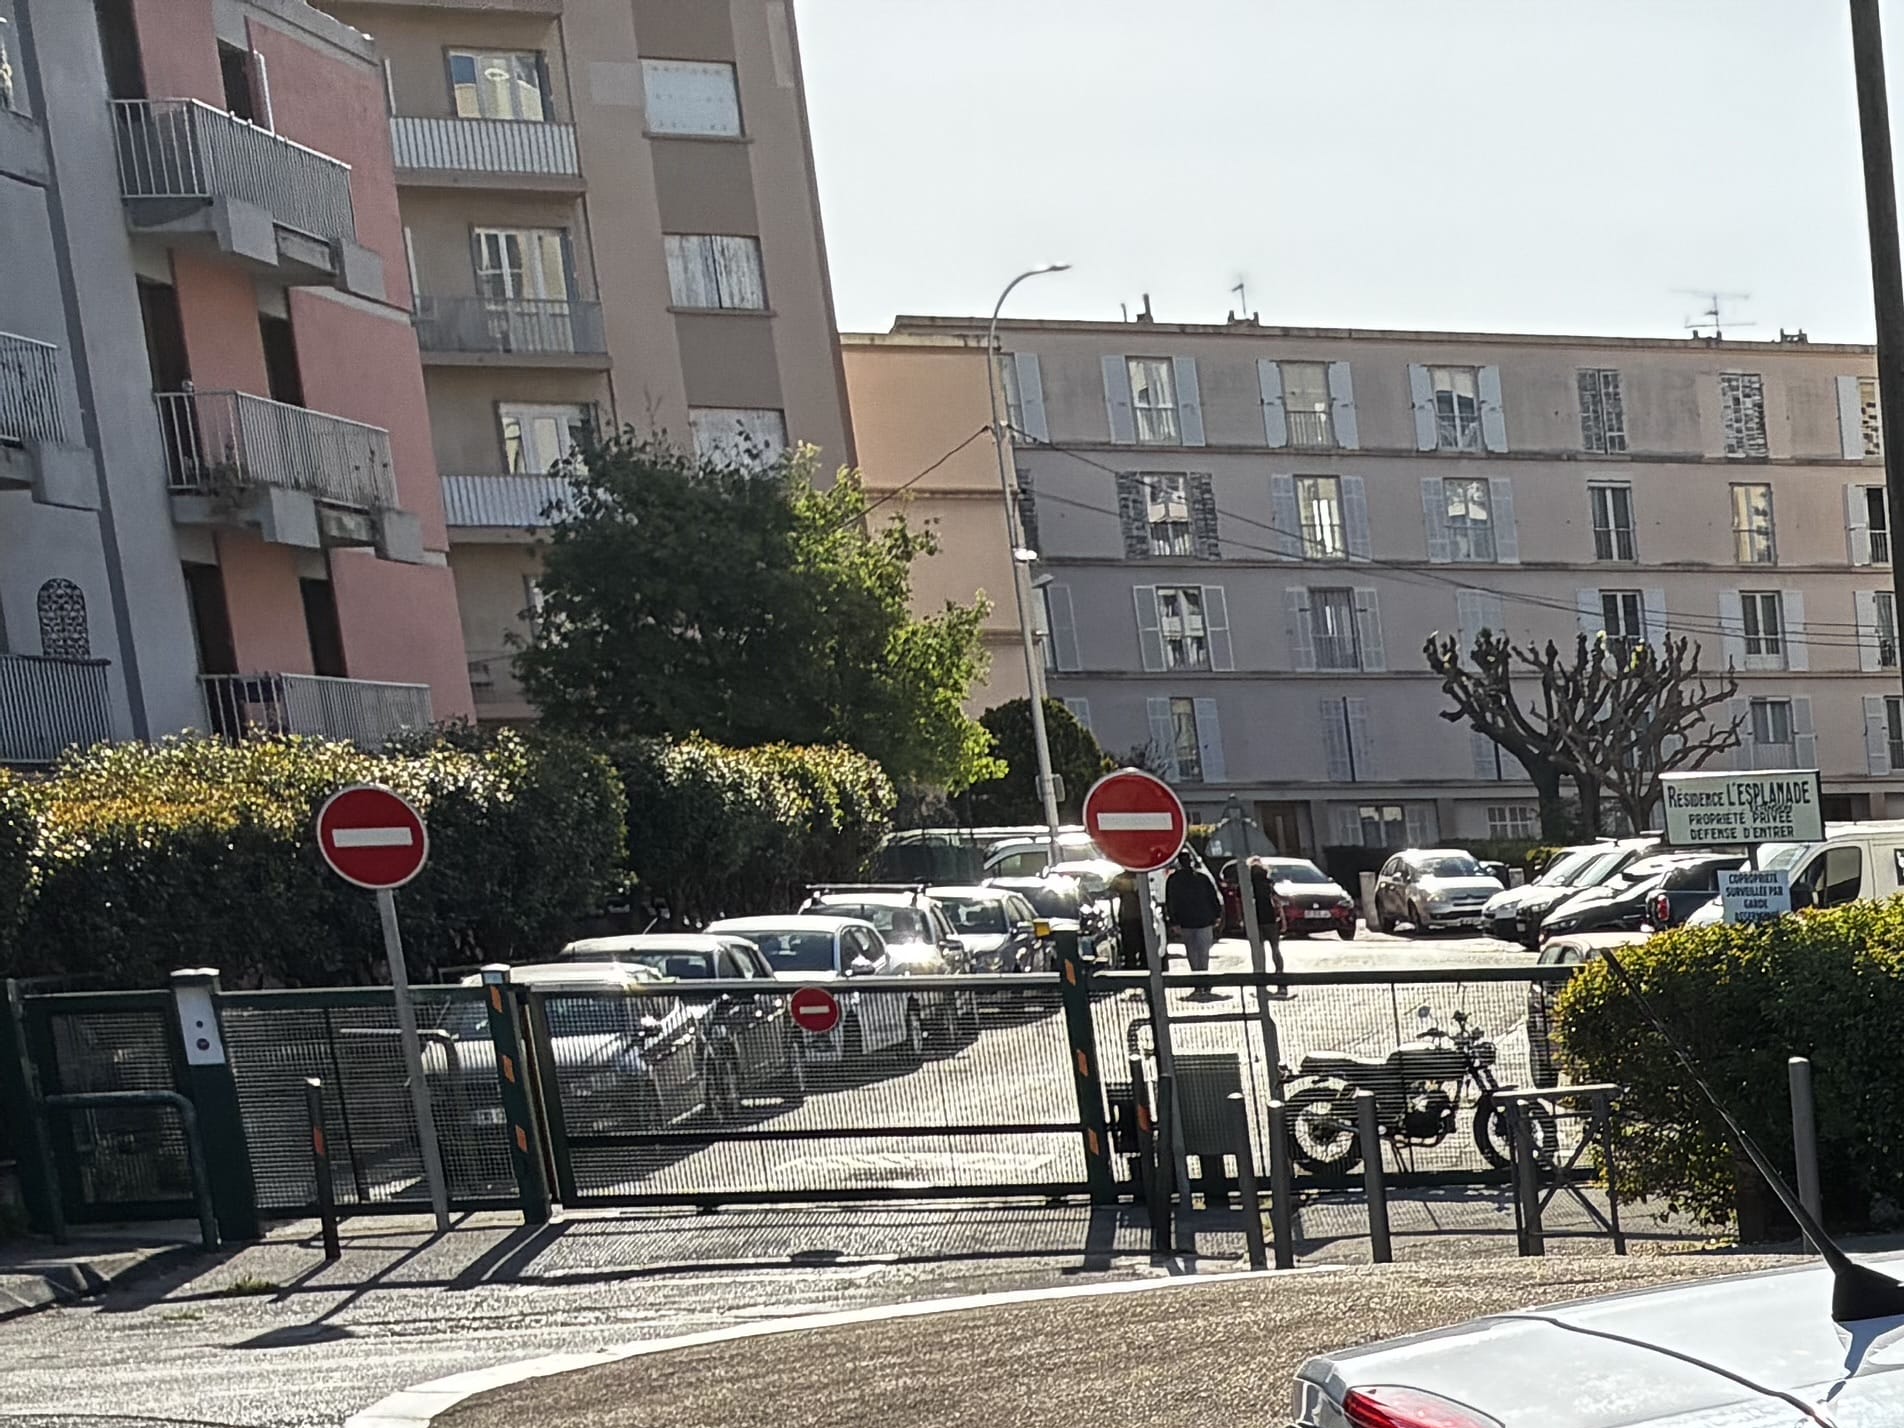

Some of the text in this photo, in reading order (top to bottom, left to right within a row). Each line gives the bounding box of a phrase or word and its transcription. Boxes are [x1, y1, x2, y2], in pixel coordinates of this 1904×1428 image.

[1727, 781, 1811, 806] L'ESPLANADE
[1743, 825, 1794, 839] D'ENTRER
[1768, 886, 1784, 896] PAR
